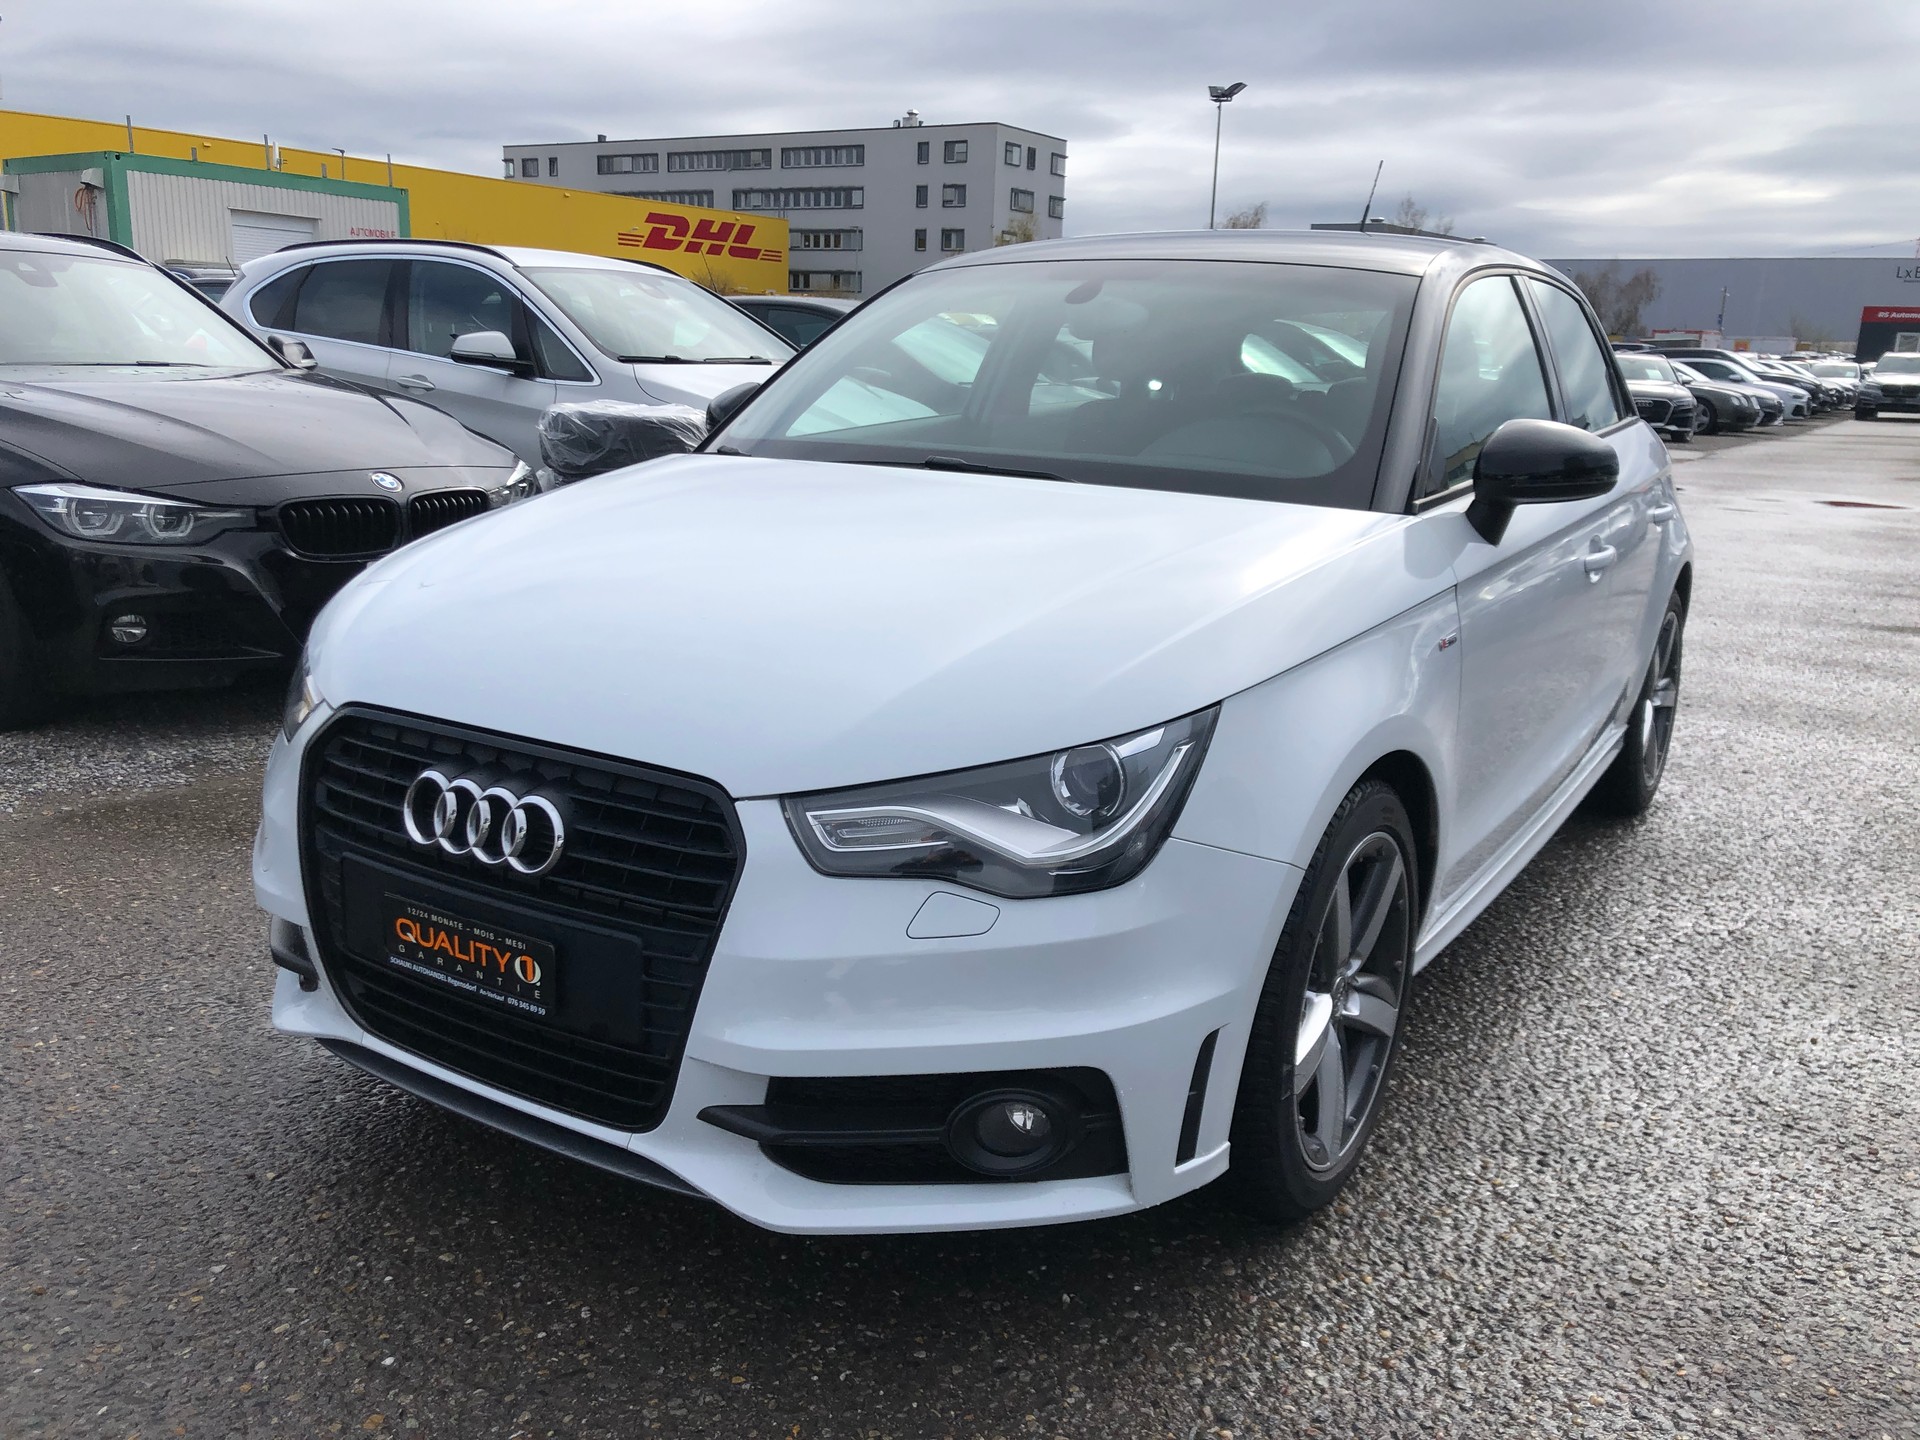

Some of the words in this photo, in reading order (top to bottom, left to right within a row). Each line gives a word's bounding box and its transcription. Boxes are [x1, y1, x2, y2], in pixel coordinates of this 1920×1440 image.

[642, 212, 762, 260] DHL
[395, 917, 511, 973] QUALITY
[406, 907, 428, 919] 12/24
[431, 914, 463, 930] MONATE
[473, 928, 495, 940] MOIS
[505, 937, 526, 950] MESI
[398, 944, 541, 999] GARANTIE
[412, 965, 447, 982] AUTOHANDEL
[447, 976, 477, 992] Regensdorf
